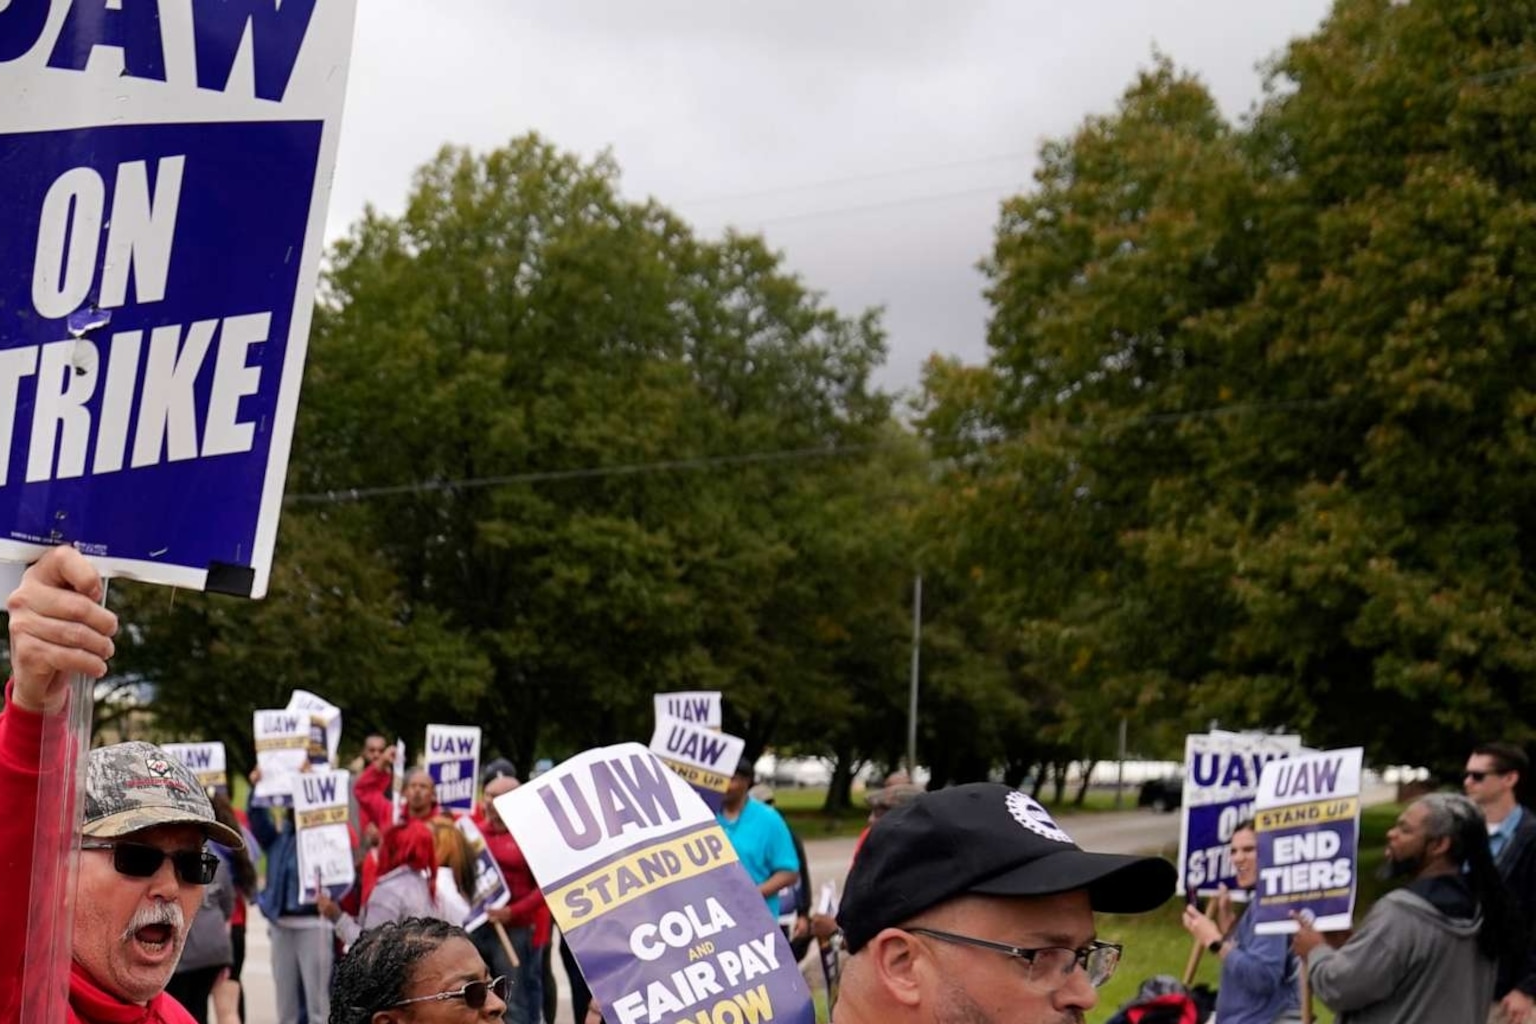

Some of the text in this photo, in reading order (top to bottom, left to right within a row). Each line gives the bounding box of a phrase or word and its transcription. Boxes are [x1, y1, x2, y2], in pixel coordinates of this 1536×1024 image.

[31, 155, 186, 320] ON
[183, 751, 212, 768] AW
[431, 735, 474, 752] UAW
[667, 725, 728, 766] UAW
[1274, 757, 1343, 797] UAW
[537, 754, 681, 851] UAW
[1263, 803, 1350, 827] STAND UP
[1273, 830, 1341, 866] END
[564, 849, 682, 919] STAND
[684, 833, 724, 865] UP
[1261, 858, 1352, 896] TIERS
[629, 897, 736, 961] COLA
[688, 942, 715, 961] AND
[720, 932, 780, 988] PAY
